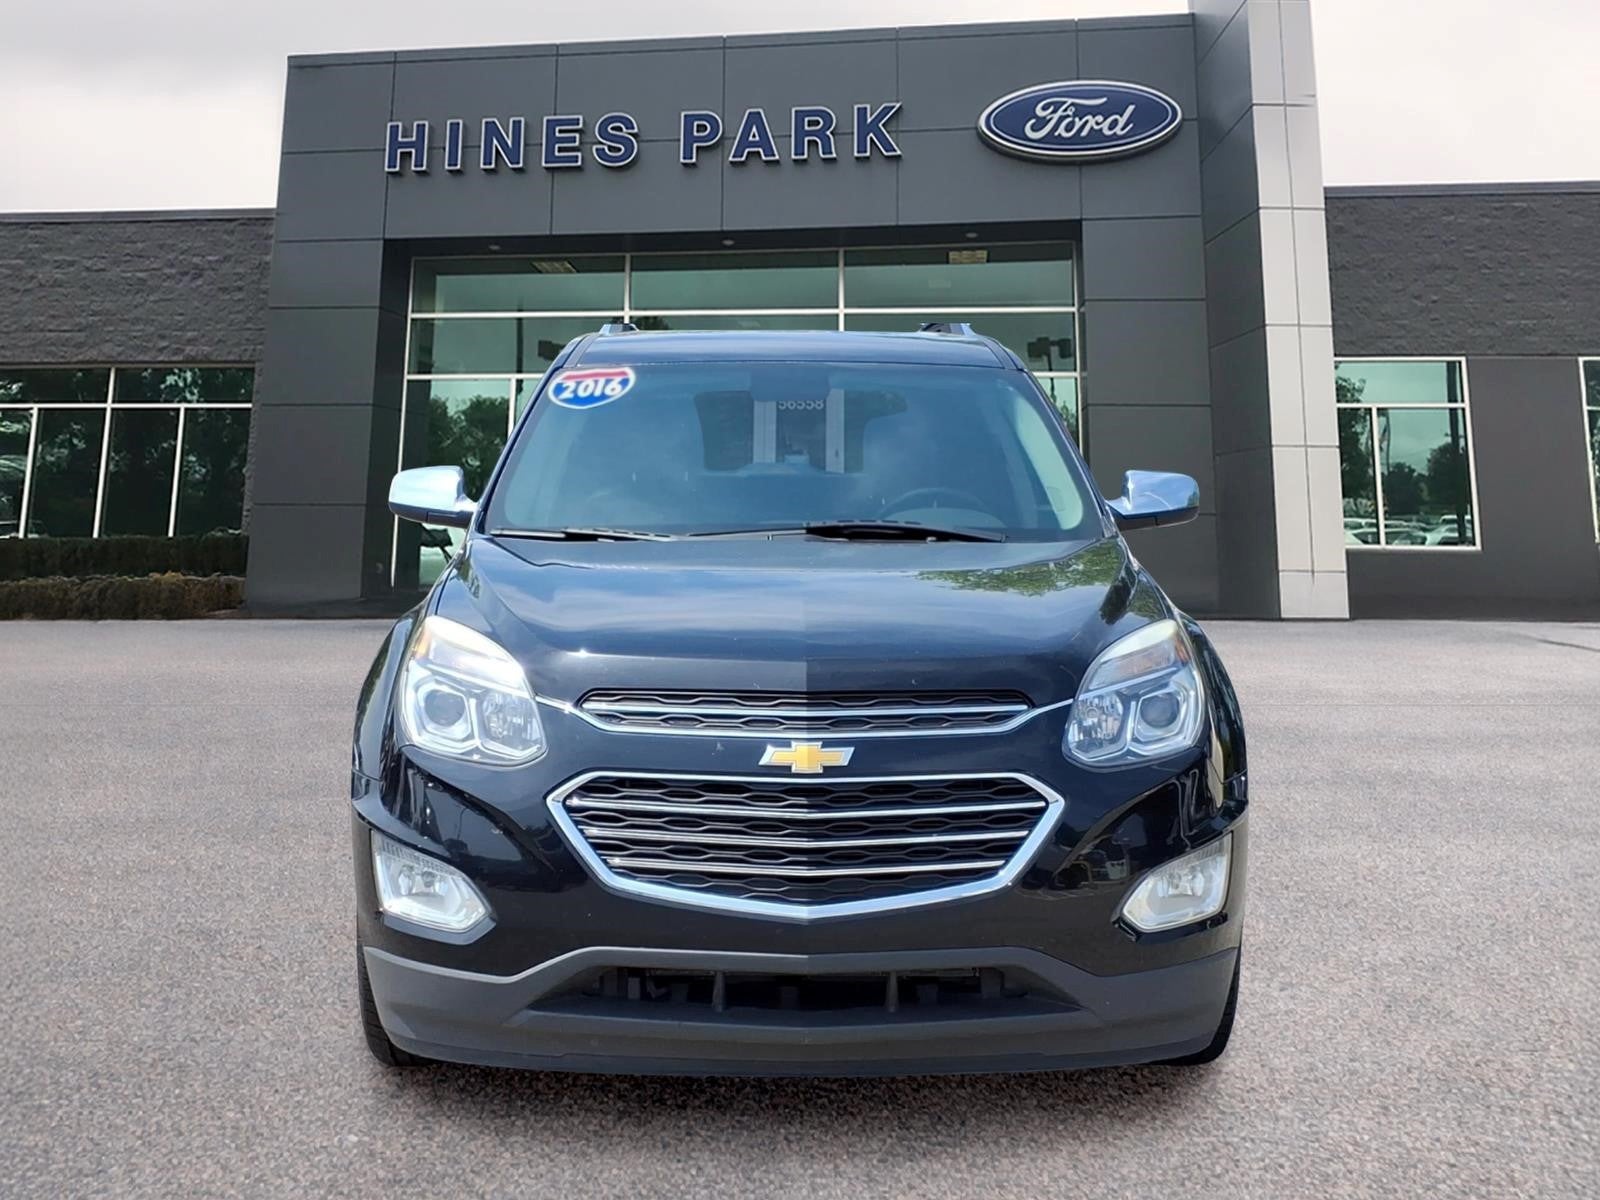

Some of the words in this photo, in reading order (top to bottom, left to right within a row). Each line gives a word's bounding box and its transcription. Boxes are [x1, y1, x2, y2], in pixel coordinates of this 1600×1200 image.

[385, 112, 639, 173] HINES
[680, 102, 902, 163] PARK
[1024, 97, 1136, 140] Ford
[558, 378, 623, 399] 2016
